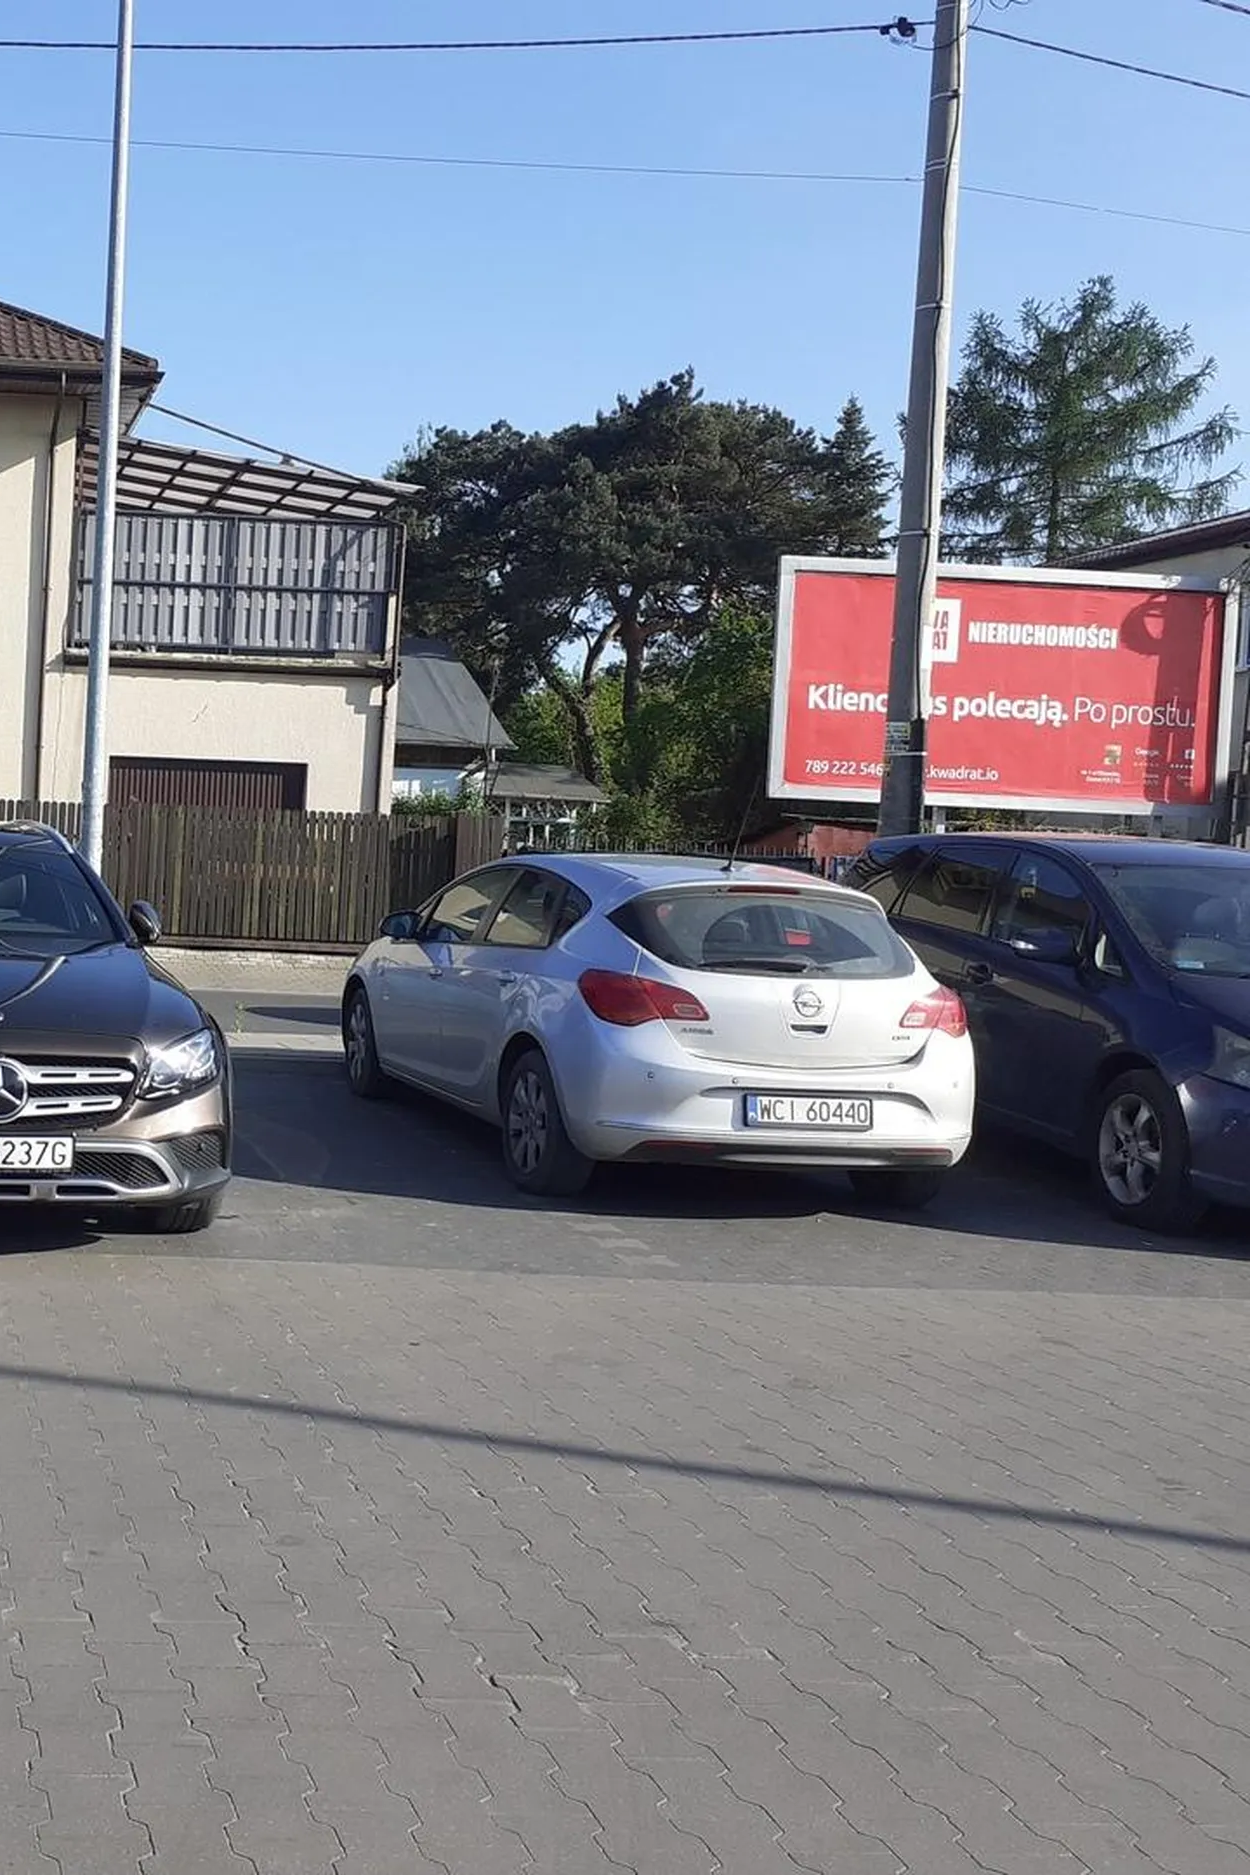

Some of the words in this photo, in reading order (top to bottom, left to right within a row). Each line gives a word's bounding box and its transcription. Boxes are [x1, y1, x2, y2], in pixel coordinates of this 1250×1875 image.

[968, 620, 1118, 649] NIERUCHOMOŚCI
[808, 684, 888, 713] Klienc
[953, 692, 1068, 728] polecają.
[1075, 697, 1105, 719] Po
[1111, 698, 1196, 728] prostu.
[805, 759, 829, 774] 789
[833, 761, 856, 775] 222
[860, 763, 884, 776] 546
[760, 1100, 795, 1121] WCI
[806, 1102, 869, 1124] 60440
